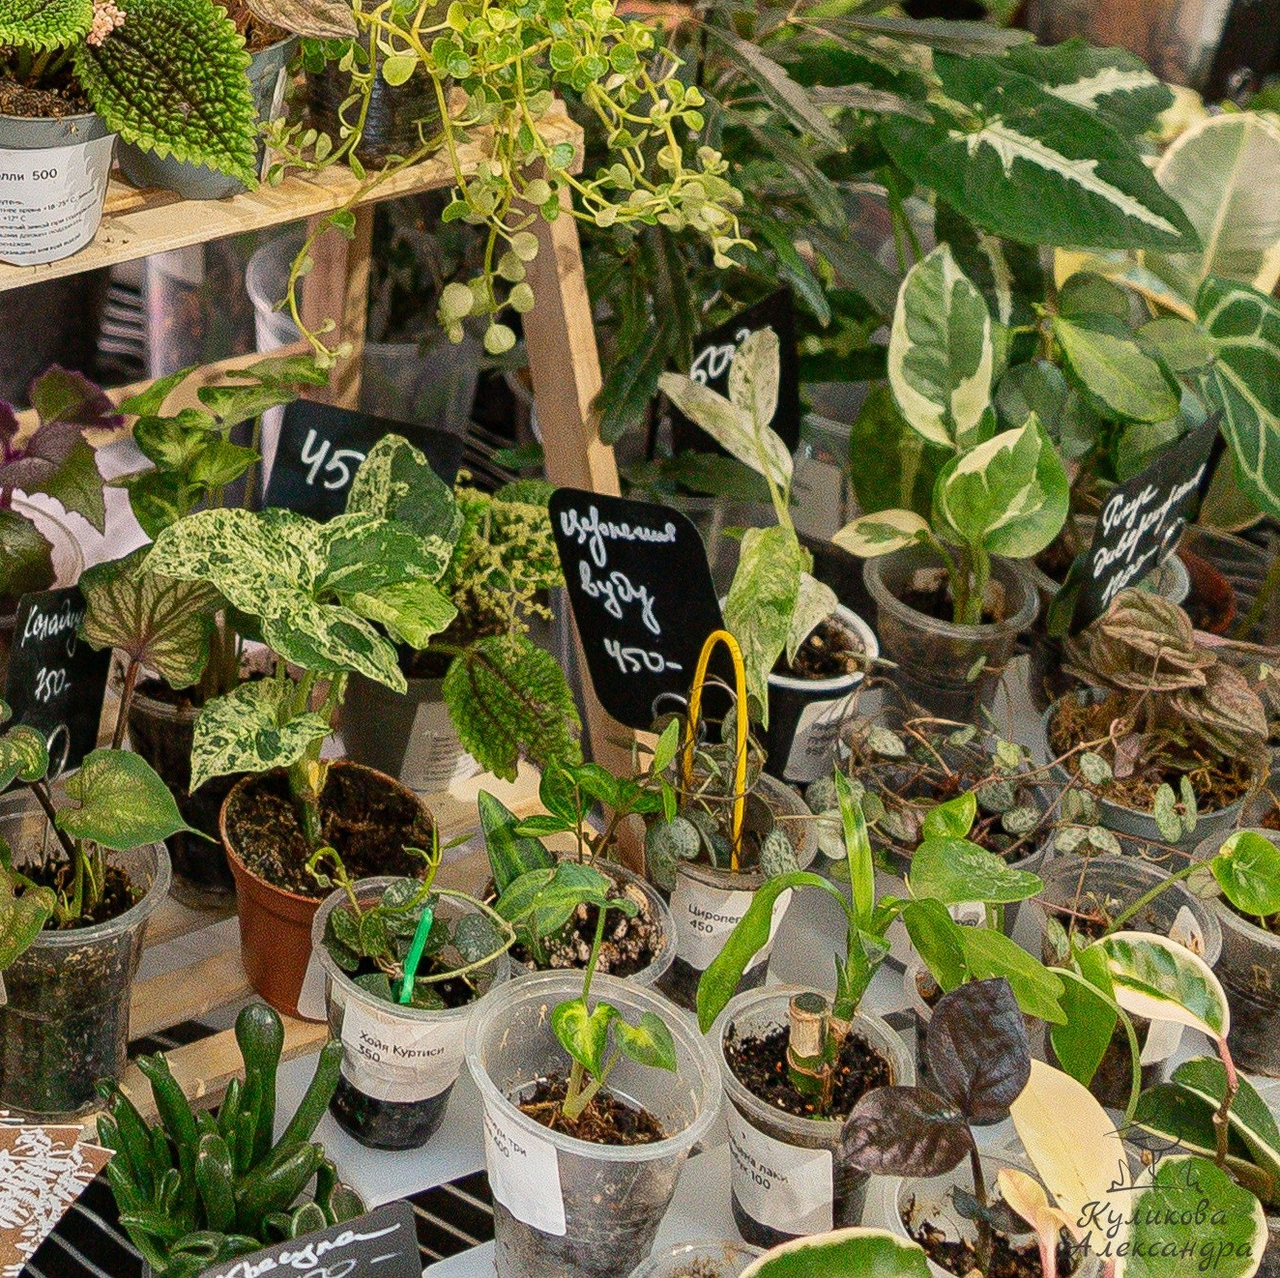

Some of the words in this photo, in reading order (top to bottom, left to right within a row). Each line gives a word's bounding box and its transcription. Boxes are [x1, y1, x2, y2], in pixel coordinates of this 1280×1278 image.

[32, 168, 58, 181] 500
[300, 428, 367, 490] 45
[688, 903, 742, 924] Циропег
[689, 919, 714, 933] 450
[359, 1030, 390, 1054] Хойя
[358, 1043, 381, 1063] 350
[751, 1170, 771, 1190] 100
